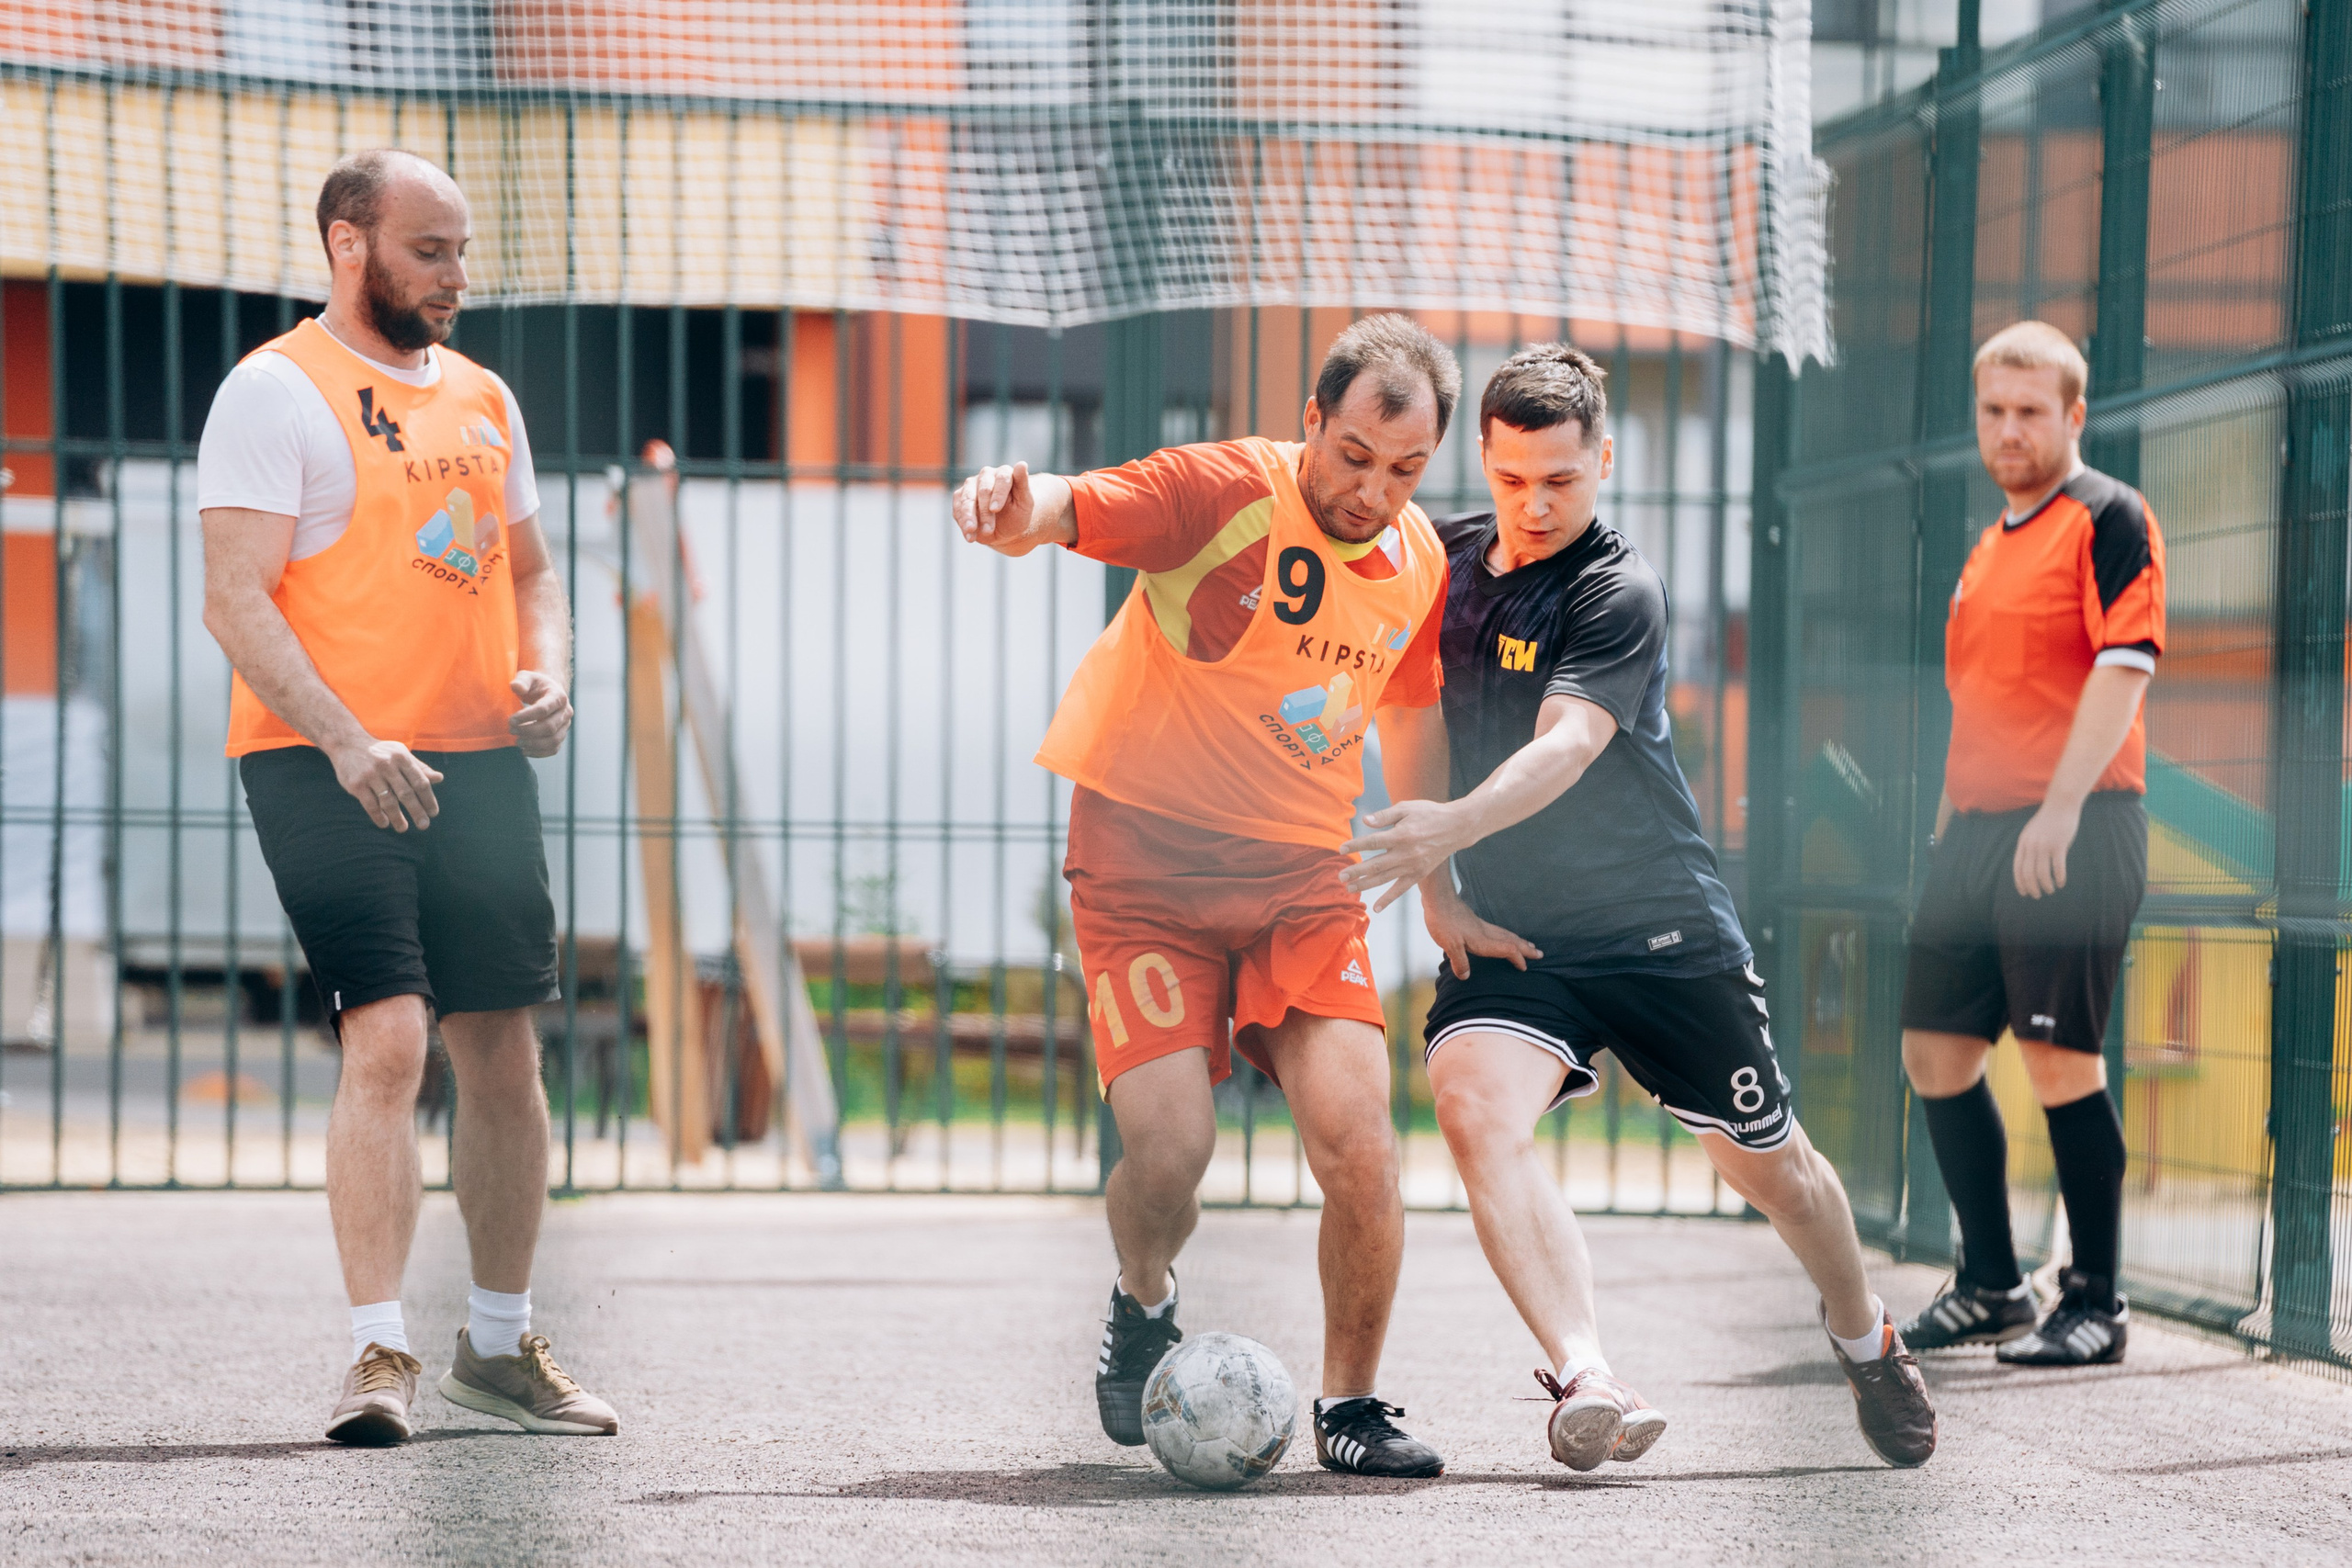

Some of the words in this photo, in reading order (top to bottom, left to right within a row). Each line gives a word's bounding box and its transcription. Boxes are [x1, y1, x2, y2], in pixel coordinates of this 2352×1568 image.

[356, 386, 405, 452] 4
[404, 455, 502, 483] KIPSTA
[412, 558, 469, 589] СПОРТ
[1273, 546, 1326, 626] 9
[1238, 593, 1259, 612] PE
[1259, 714, 1306, 758] СПОРТ
[1321, 734, 1363, 765] ДОМА
[1093, 953, 1185, 1048] 10
[1340, 969, 1368, 988] PEAK
[1730, 1066, 1765, 1113] 8
